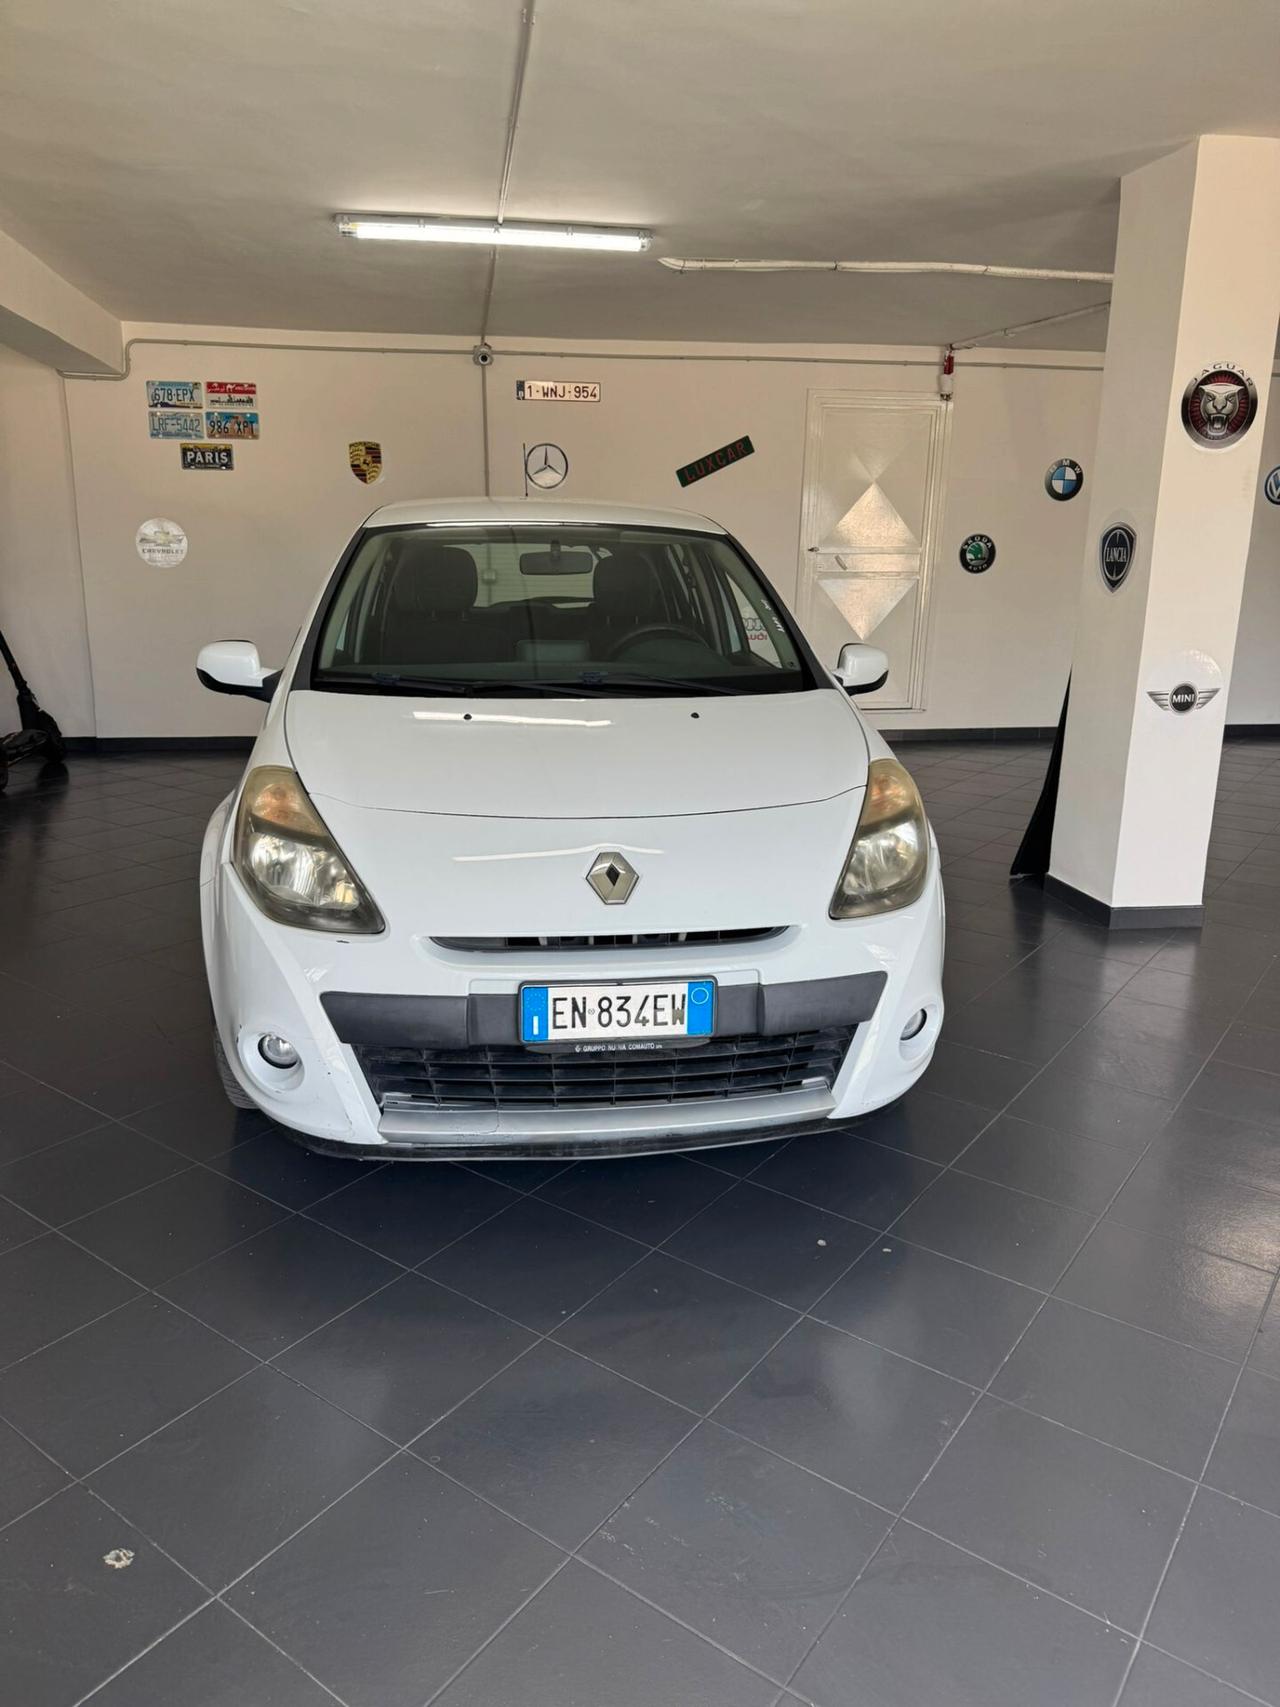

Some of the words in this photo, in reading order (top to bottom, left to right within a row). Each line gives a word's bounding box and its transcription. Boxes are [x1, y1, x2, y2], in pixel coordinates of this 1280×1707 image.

[1193, 363, 1254, 386] JAGUAR
[209, 420, 230, 434] 986
[187, 451, 228, 464] PARIS
[684, 441, 748, 481] LUXCAR
[1049, 459, 1082, 474] BMW
[1173, 694, 1195, 704] MINI
[552, 997, 587, 1030] EN
[597, 993, 686, 1028] 834EW
[583, 1044, 606, 1052] GRUPPO
